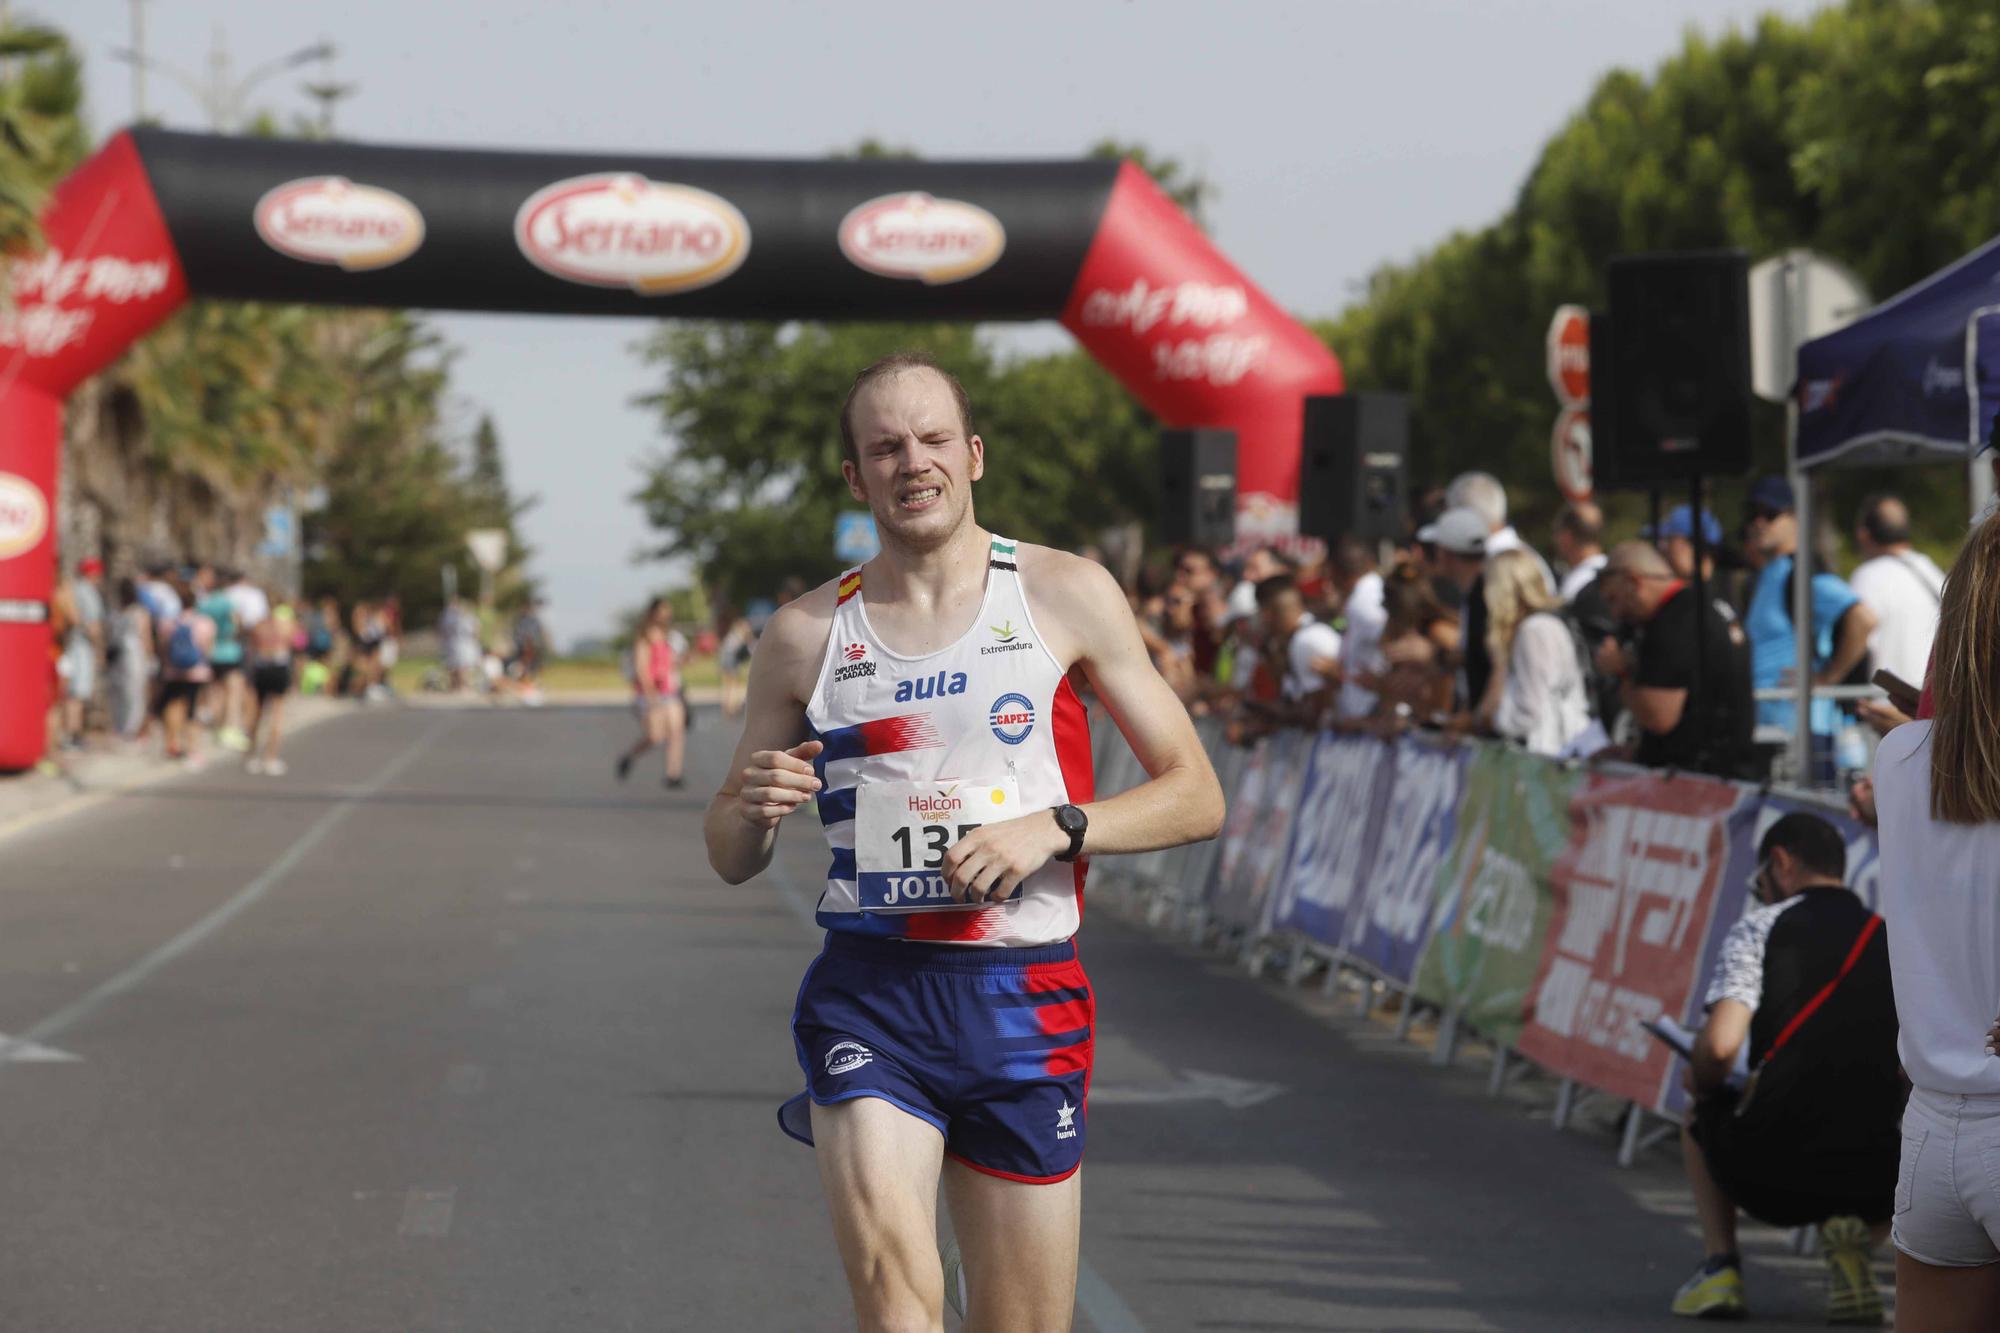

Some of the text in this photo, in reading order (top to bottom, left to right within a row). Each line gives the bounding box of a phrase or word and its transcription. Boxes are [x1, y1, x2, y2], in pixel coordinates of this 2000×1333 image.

[980, 641, 1034, 656] Extremadura
[834, 660, 877, 676] DIPUTACIÓN
[842, 669, 877, 681] BADAJOZ
[894, 670, 968, 703] aula
[996, 712, 1031, 726] CAPEX
[920, 810, 951, 823] viajes
